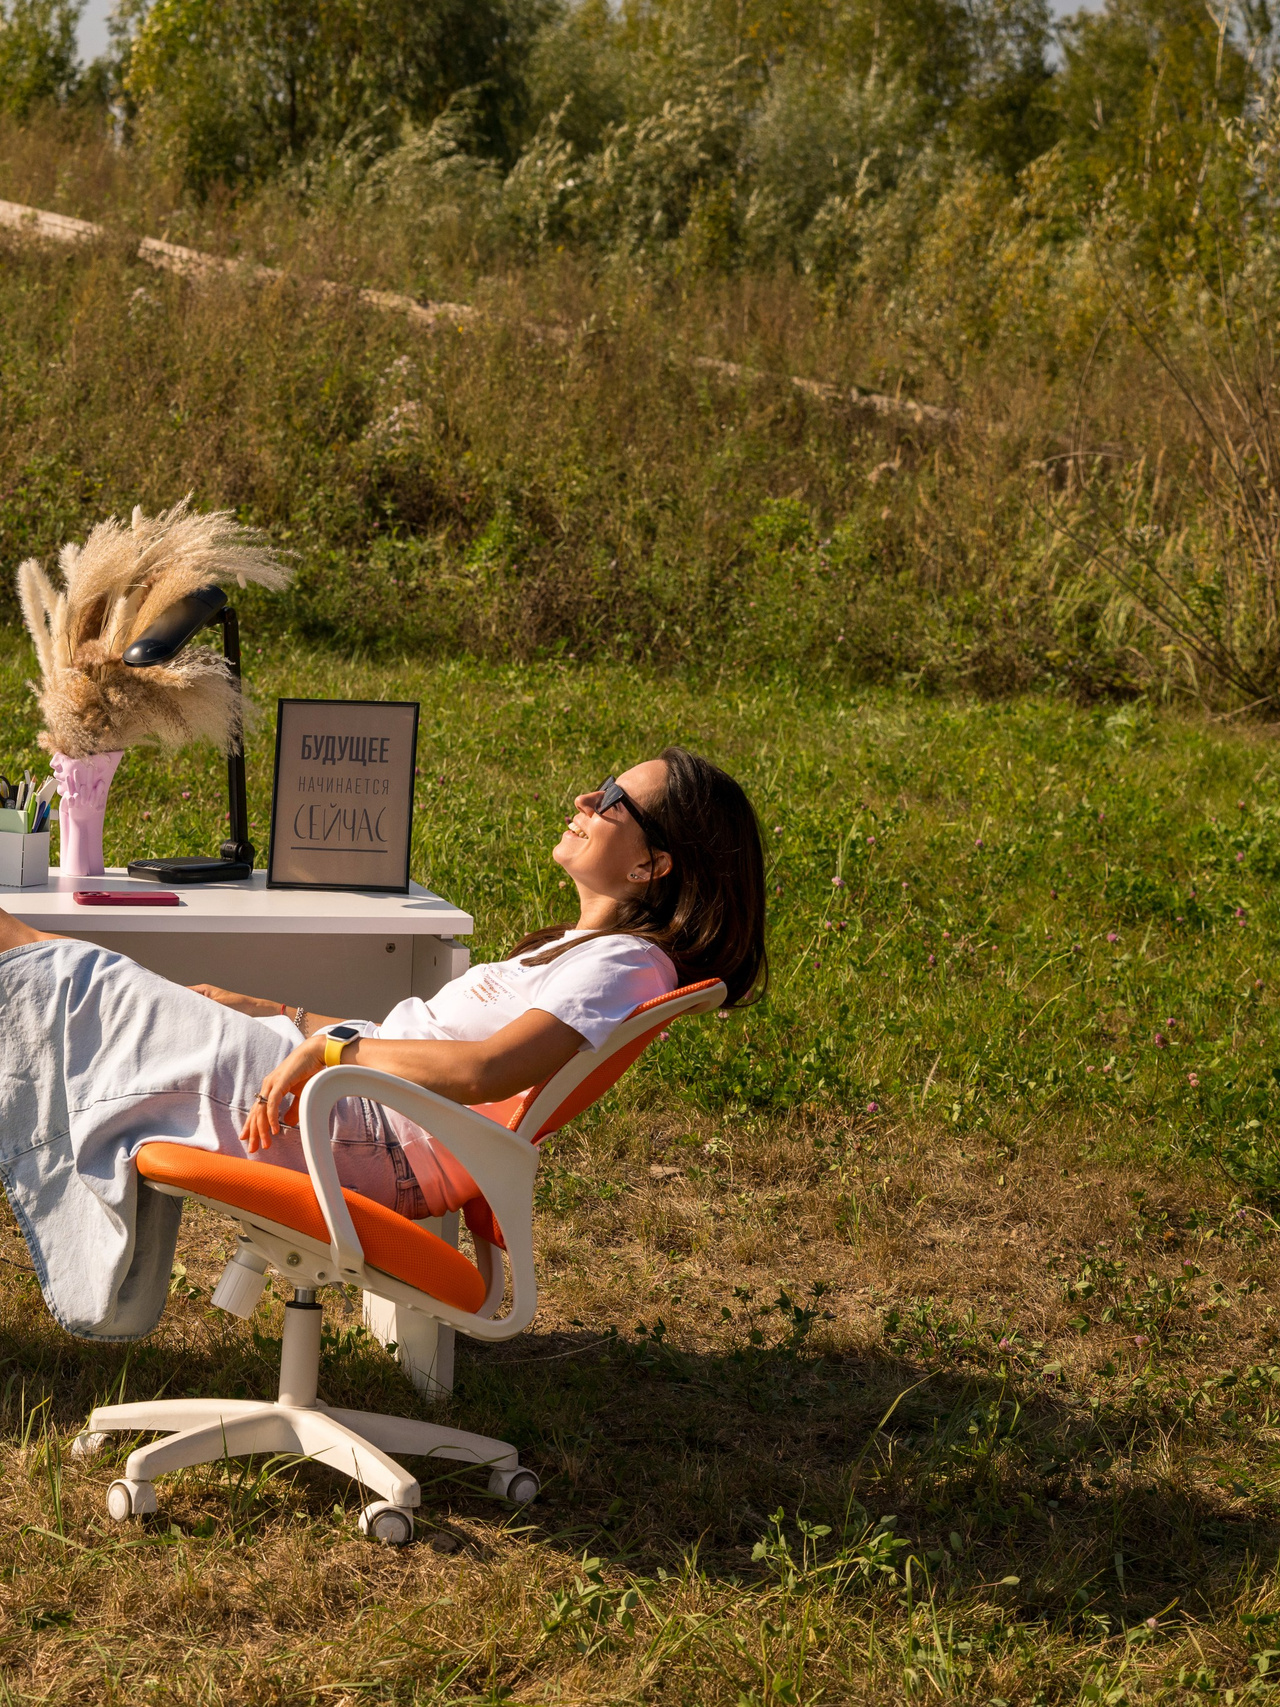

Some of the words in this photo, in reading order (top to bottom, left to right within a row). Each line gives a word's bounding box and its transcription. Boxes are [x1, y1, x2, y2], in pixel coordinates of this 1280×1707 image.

[301, 734, 391, 767] БУДУЩЕЕ
[298, 775, 390, 795] НАЧИНАЕТСЯ
[293, 802, 388, 842] СЕЙЧАС
